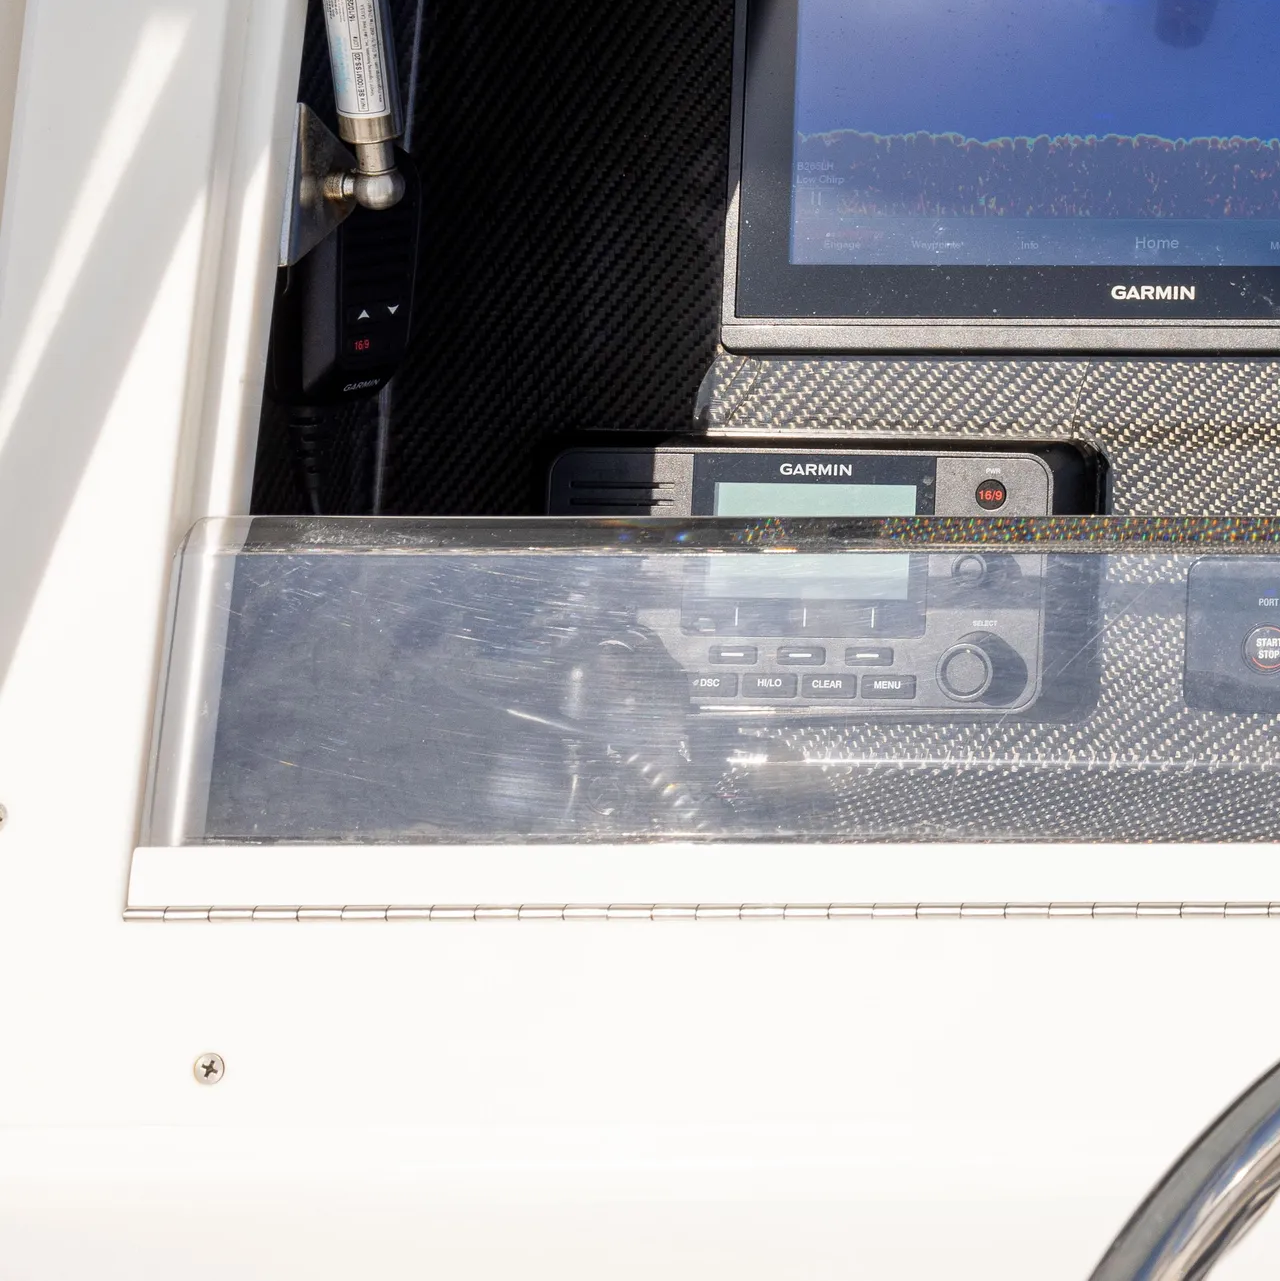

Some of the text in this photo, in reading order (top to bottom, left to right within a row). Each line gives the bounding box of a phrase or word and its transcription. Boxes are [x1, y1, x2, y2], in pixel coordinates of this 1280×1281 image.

[796, 175, 845, 186] Low Chirp
[823, 240, 862, 251] Engage
[1020, 241, 1039, 250] Info
[1135, 236, 1179, 250] Home
[1110, 285, 1196, 301] GARMIN
[343, 378, 381, 392] GARMIN
[779, 463, 852, 476] GARMIN
[978, 490, 1003, 501] 16/9
[1258, 598, 1279, 607] PORT
[1258, 649, 1280, 660] STOP
[700, 678, 720, 688] DSC
[757, 678, 782, 688] HI/LO
[811, 680, 842, 689] CLEAR
[873, 680, 901, 690] MENU
